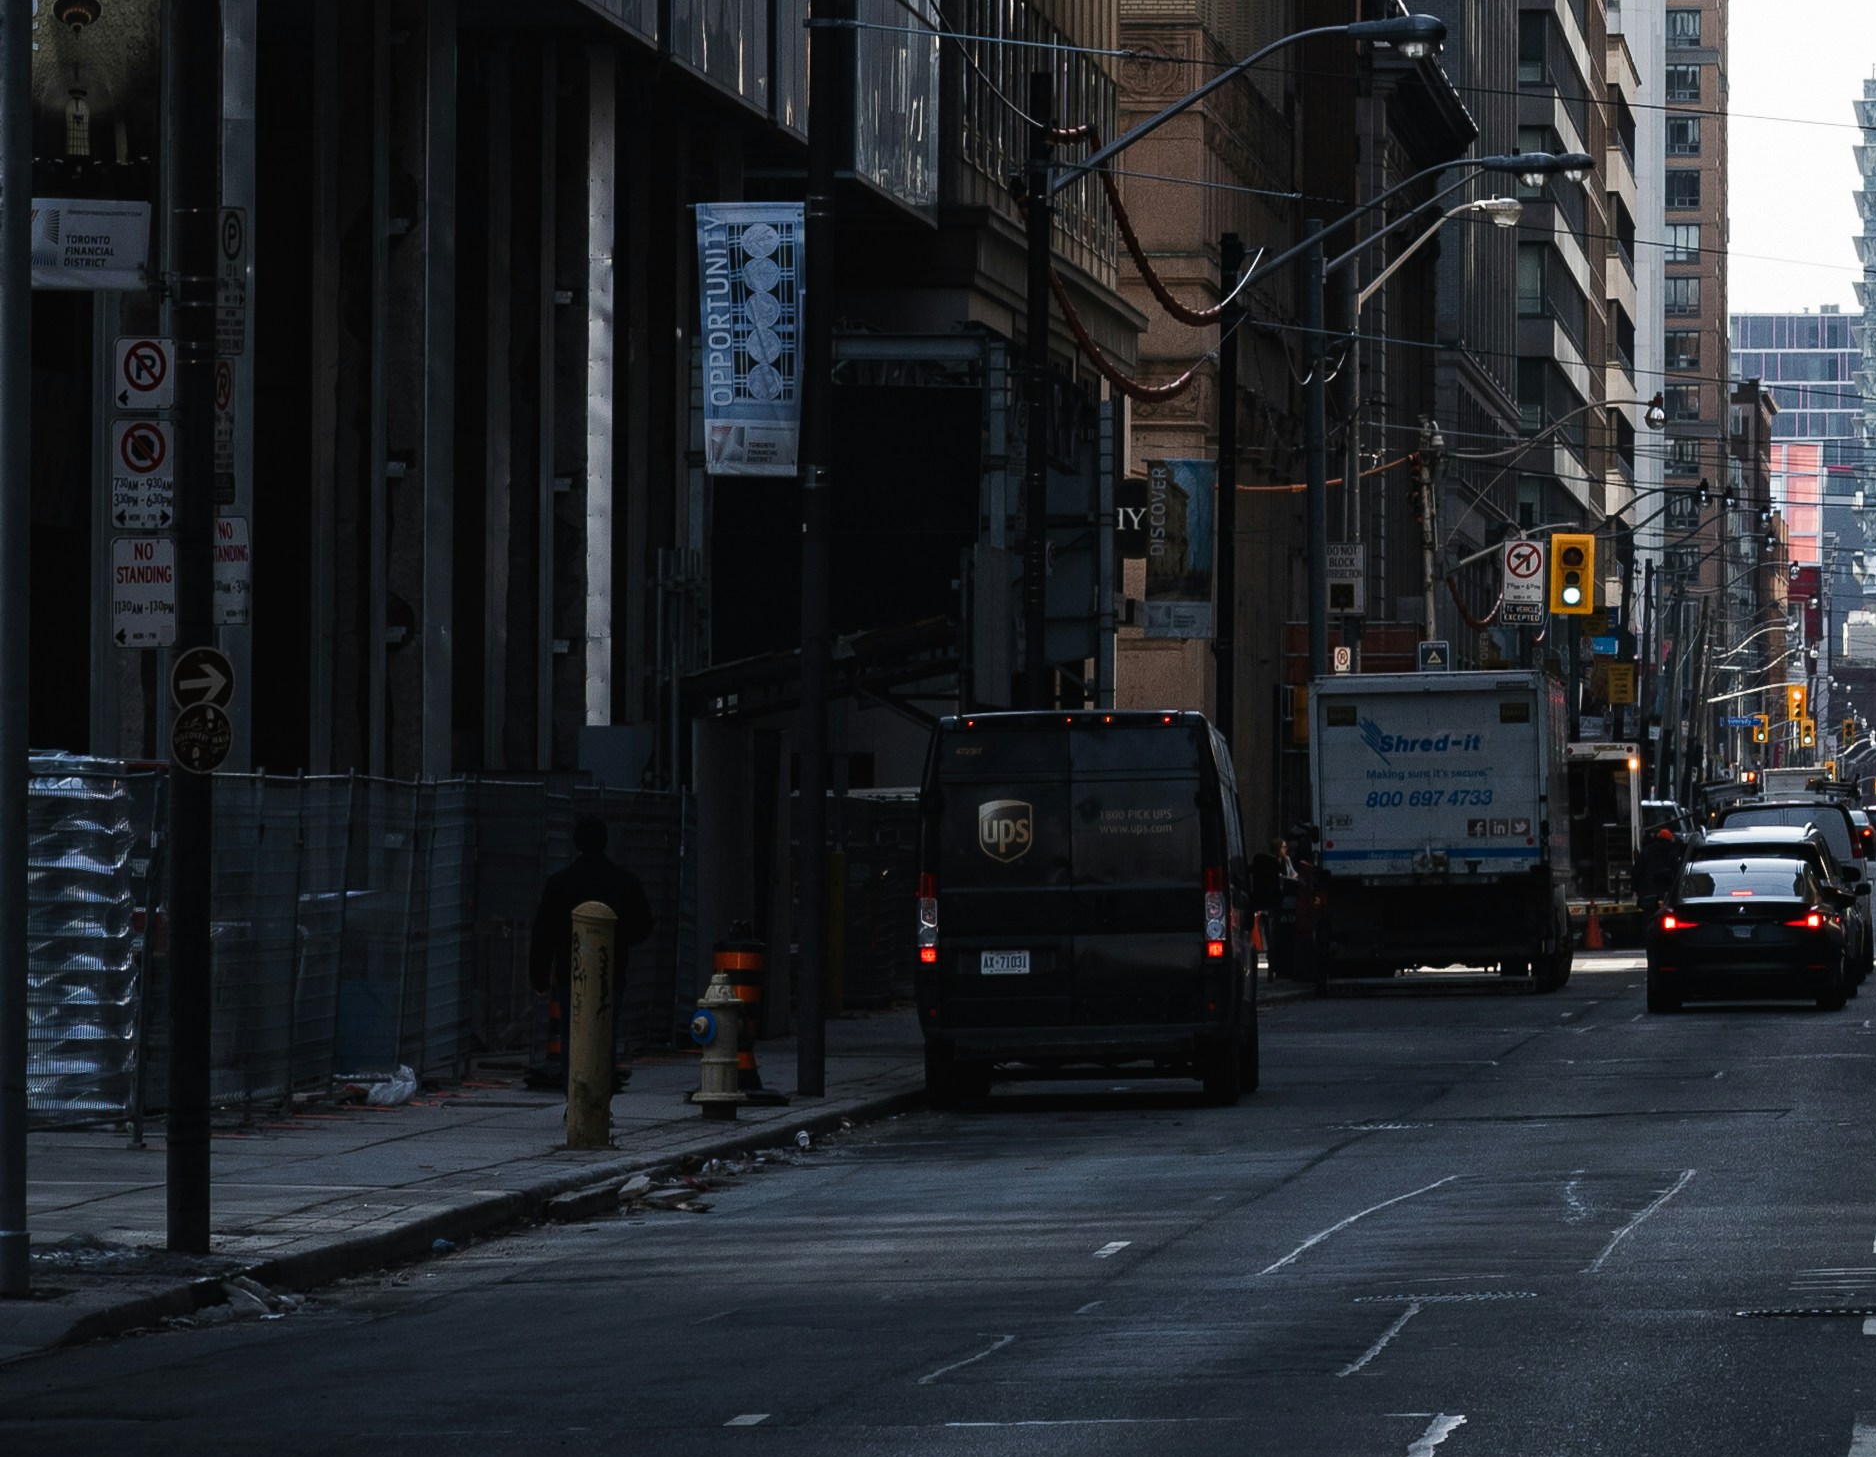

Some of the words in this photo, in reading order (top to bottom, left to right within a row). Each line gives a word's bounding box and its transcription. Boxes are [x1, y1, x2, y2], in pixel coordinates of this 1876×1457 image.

[65, 235, 111, 245] TORONTO
[64, 246, 115, 256] FINANCIAL
[63, 258, 107, 267] DISTRICT
[704, 216, 733, 407] OPPORTUNITY
[1151, 467, 1167, 556] DISCOVER
[218, 522, 233, 539] NO
[134, 543, 153, 560] NO
[1327, 546, 1339, 556] DO
[1342, 546, 1357, 556] NOT
[1329, 557, 1355, 567] BLOCK
[117, 566, 172, 584] STANDING
[1504, 614, 1540, 622] EXCEPTED
[1378, 734, 1481, 753] Shred-it
[1366, 769, 1405, 781] Making
[1408, 770, 1429, 778] sure
[1433, 769, 1449, 778] it's
[1366, 791, 1403, 807] 800
[1409, 791, 1445, 806] 697
[1447, 790, 1493, 806] 4733
[1100, 809, 1125, 821] 1800
[1128, 808, 1150, 820] PICK
[1153, 808, 1173, 819] UPS
[983, 818, 1029, 853] ups
[1100, 824, 1173, 836] www.ups.com
